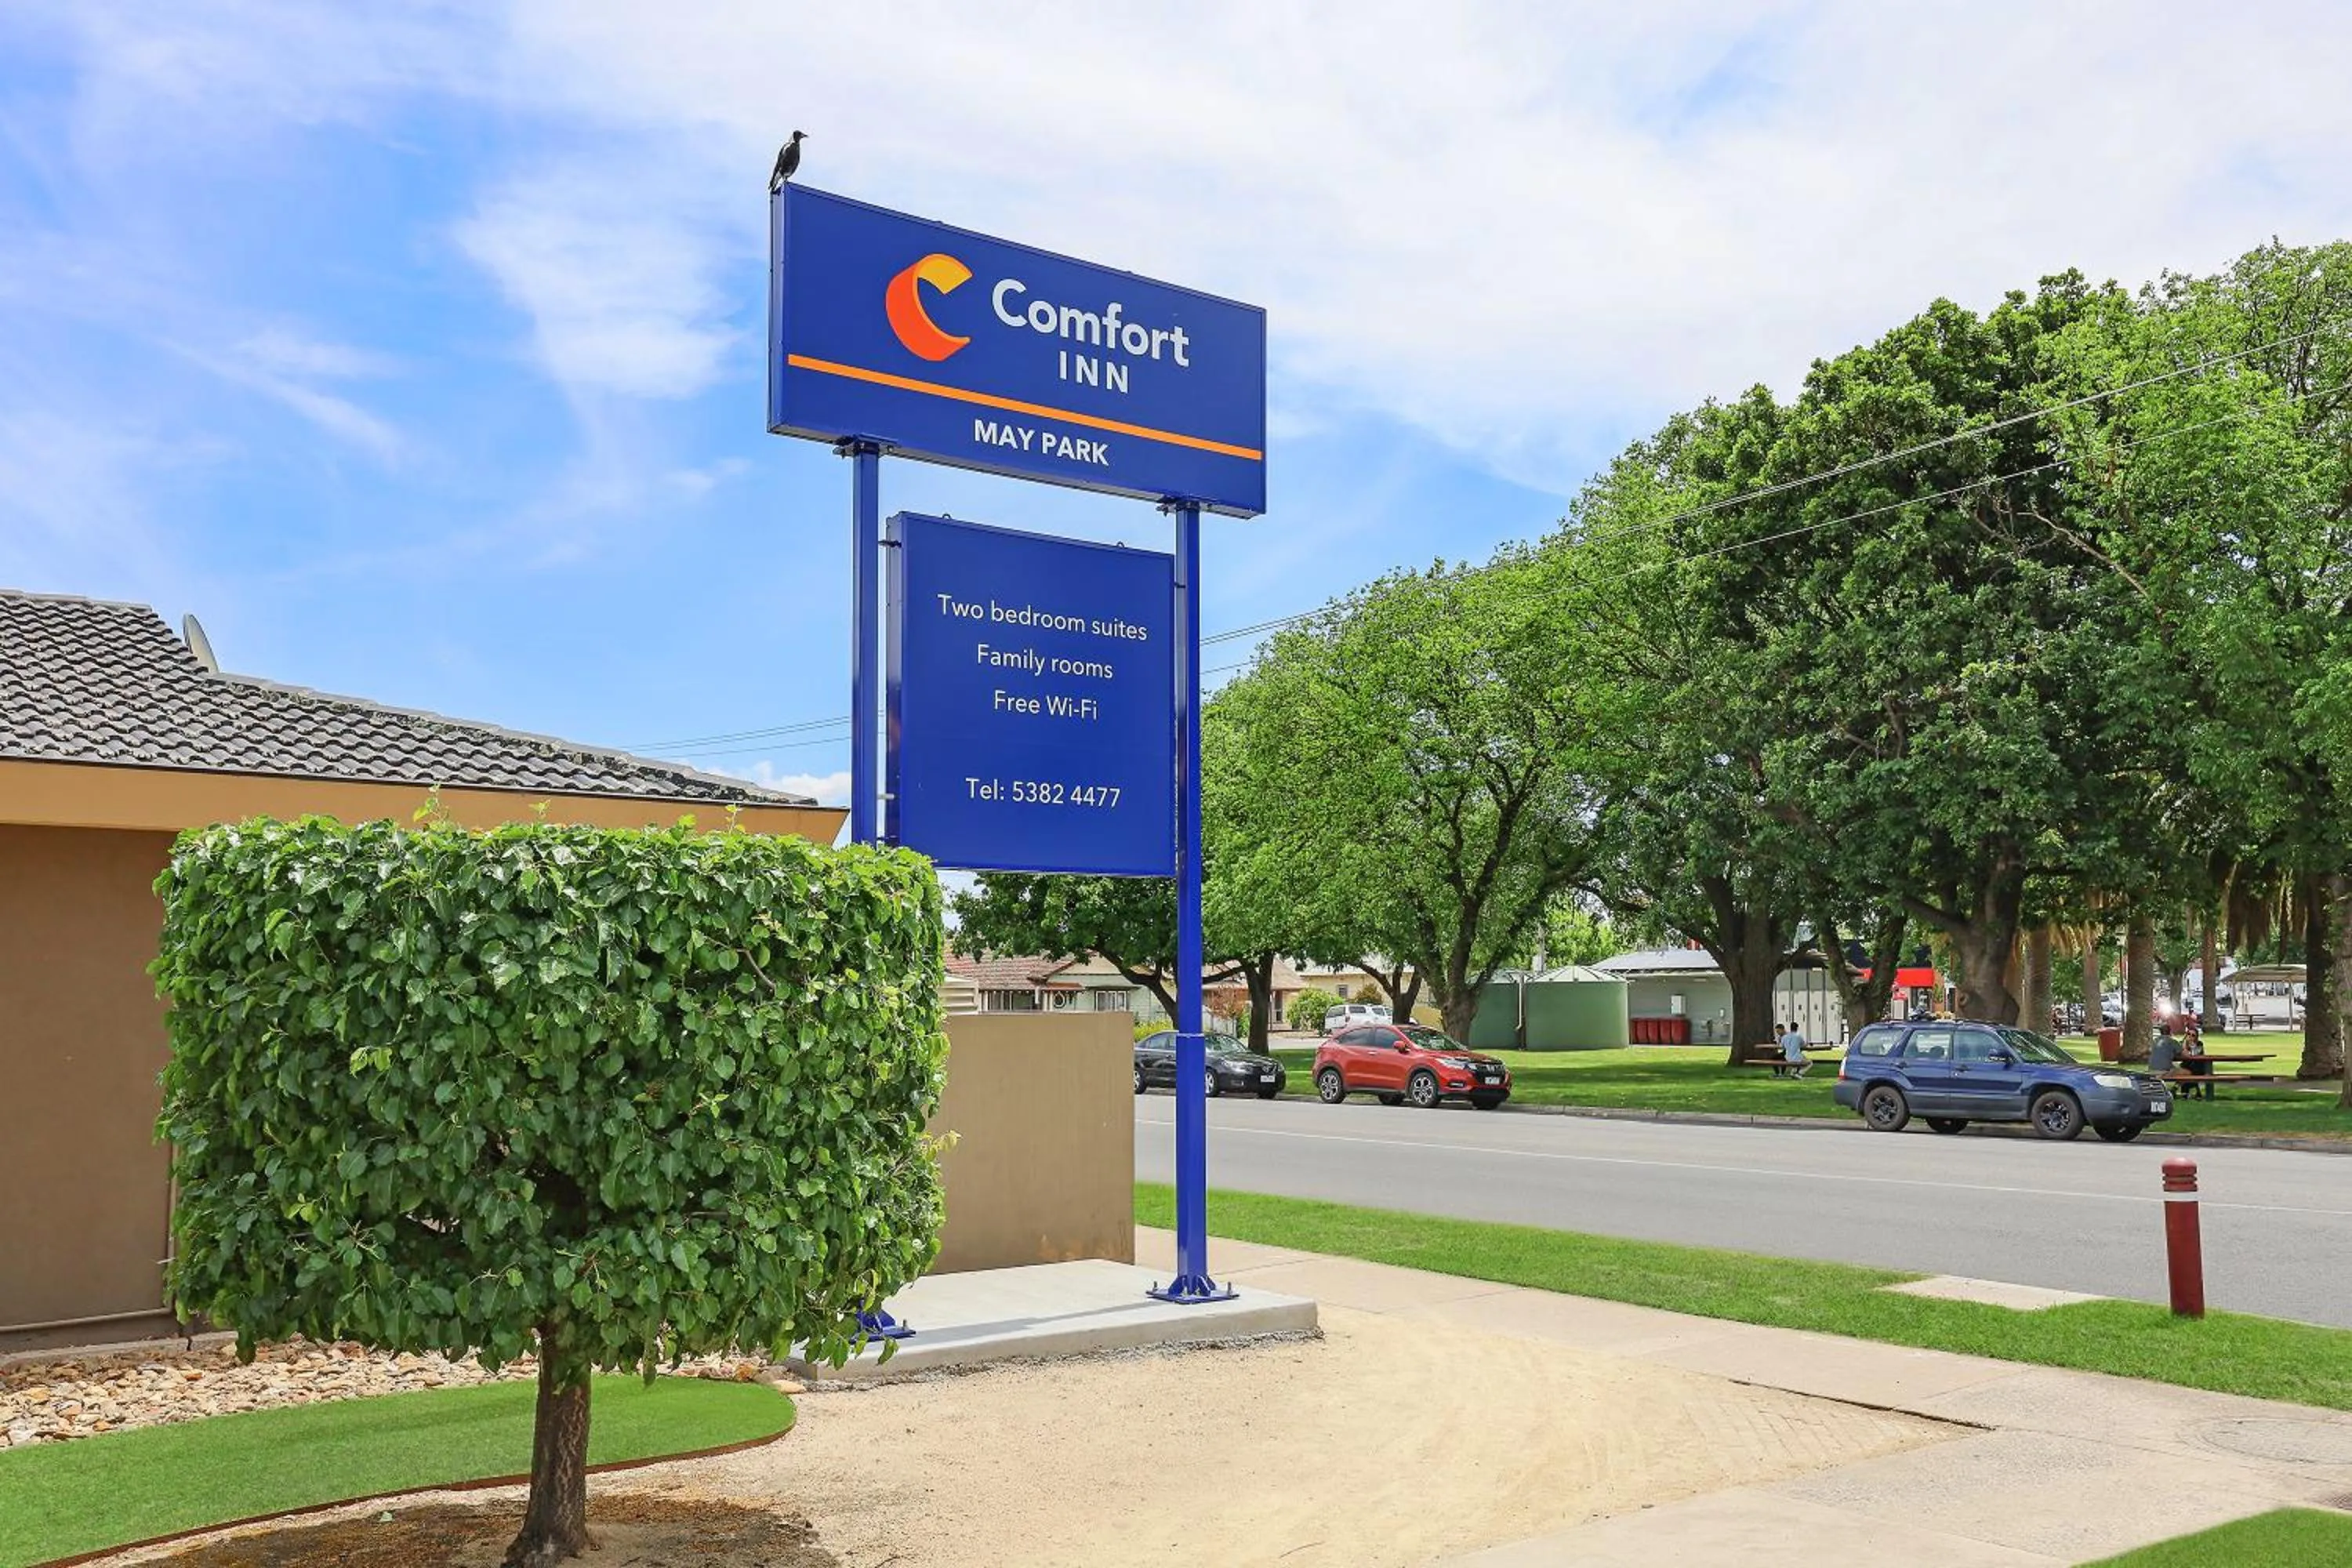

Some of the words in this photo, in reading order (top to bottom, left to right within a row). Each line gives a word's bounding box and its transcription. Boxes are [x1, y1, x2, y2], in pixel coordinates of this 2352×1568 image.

[991, 278, 1190, 368] Comfort
[1059, 350, 1130, 394] INN
[974, 419, 1036, 452] MAY
[1041, 431, 1110, 466] PARK
[937, 593, 984, 619] Two
[991, 600, 1086, 633] bedroom
[1091, 617, 1148, 641] suites
[977, 644, 1045, 677] Family
[1051, 658, 1113, 679] rooms
[994, 689, 1040, 714] Free
[1046, 695, 1098, 720] Wi-Fi
[965, 777, 1005, 800] Tel:
[1012, 781, 1064, 804] 5382
[1070, 786, 1121, 808] 4477
